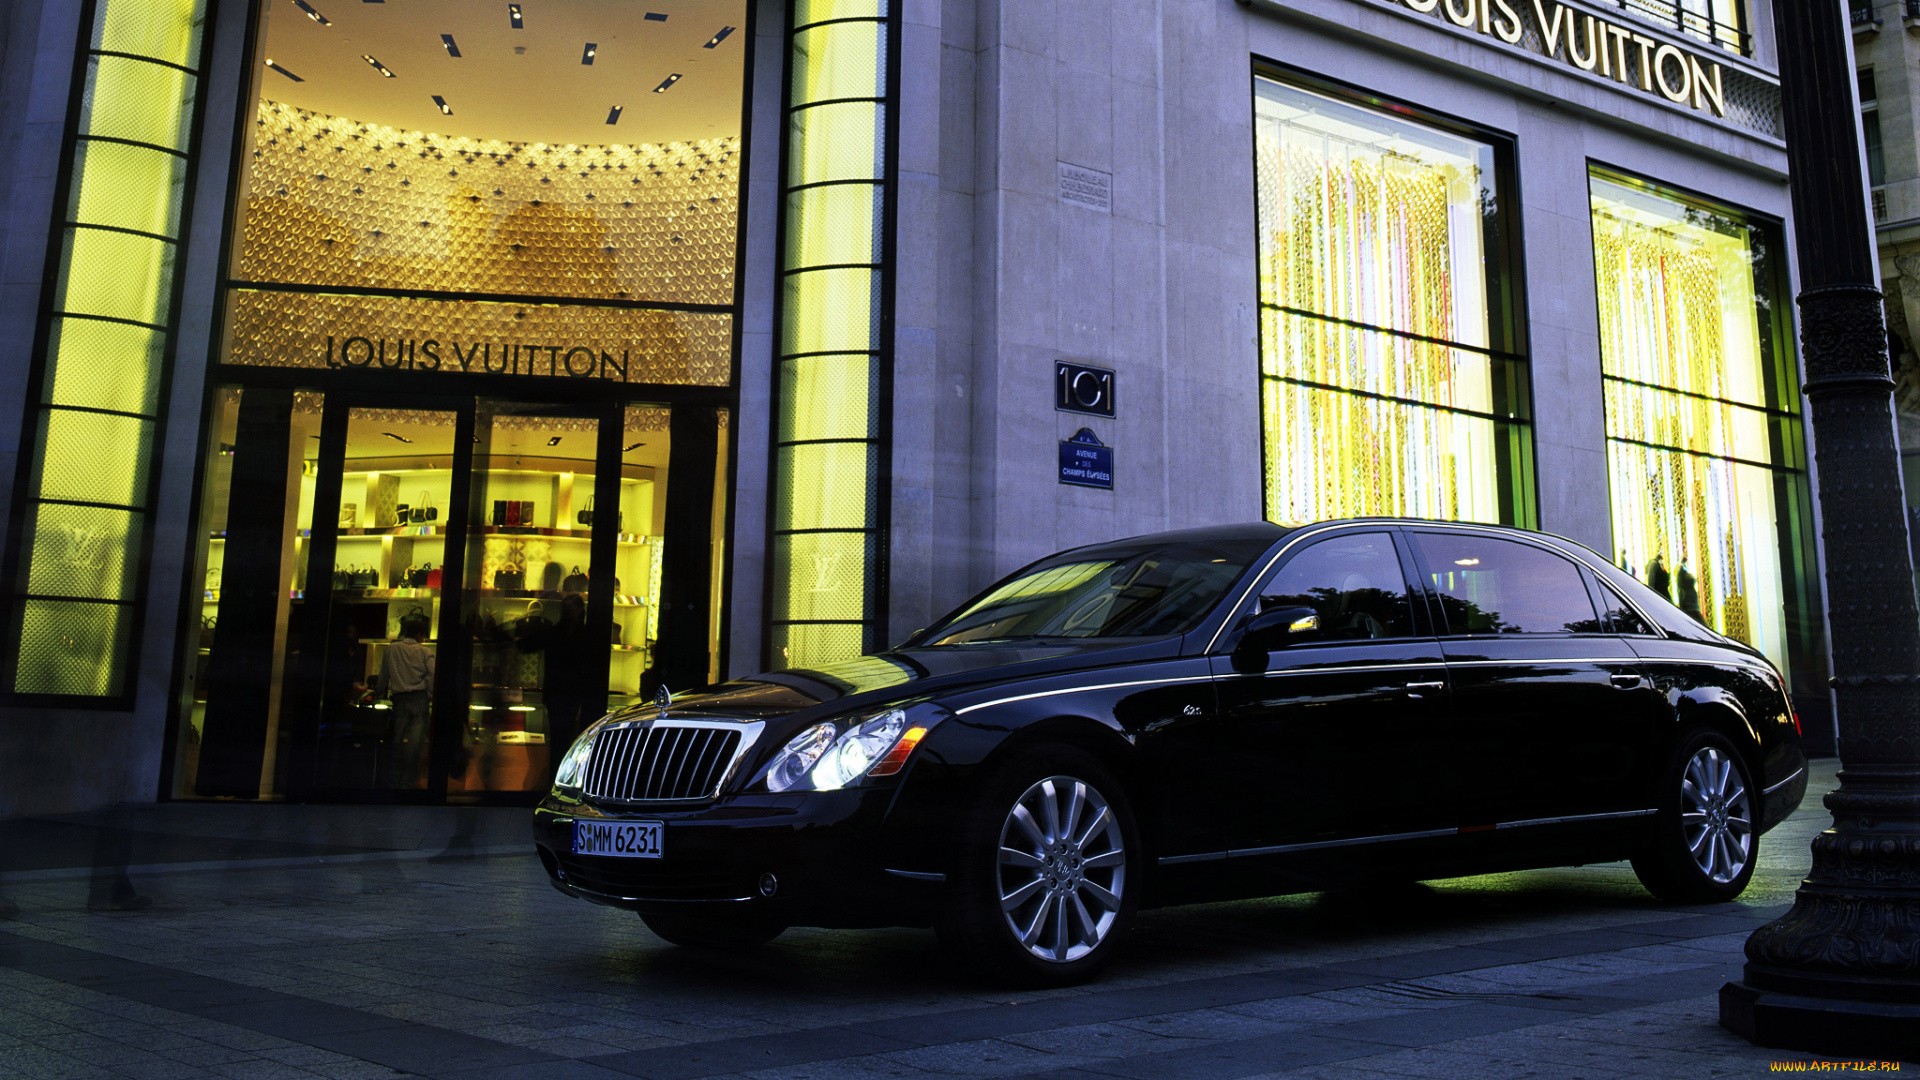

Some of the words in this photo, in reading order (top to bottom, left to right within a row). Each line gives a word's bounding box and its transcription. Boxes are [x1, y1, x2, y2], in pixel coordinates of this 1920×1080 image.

[1532, 0, 1725, 118] VUITTON
[326, 335, 441, 371] LOUIS
[452, 342, 629, 383] VUITTON
[1060, 367, 1110, 411] 101
[1062, 467, 1086, 478] CHAMPS
[1076, 449, 1098, 460] AVENUE
[615, 826, 660, 854] 6231
